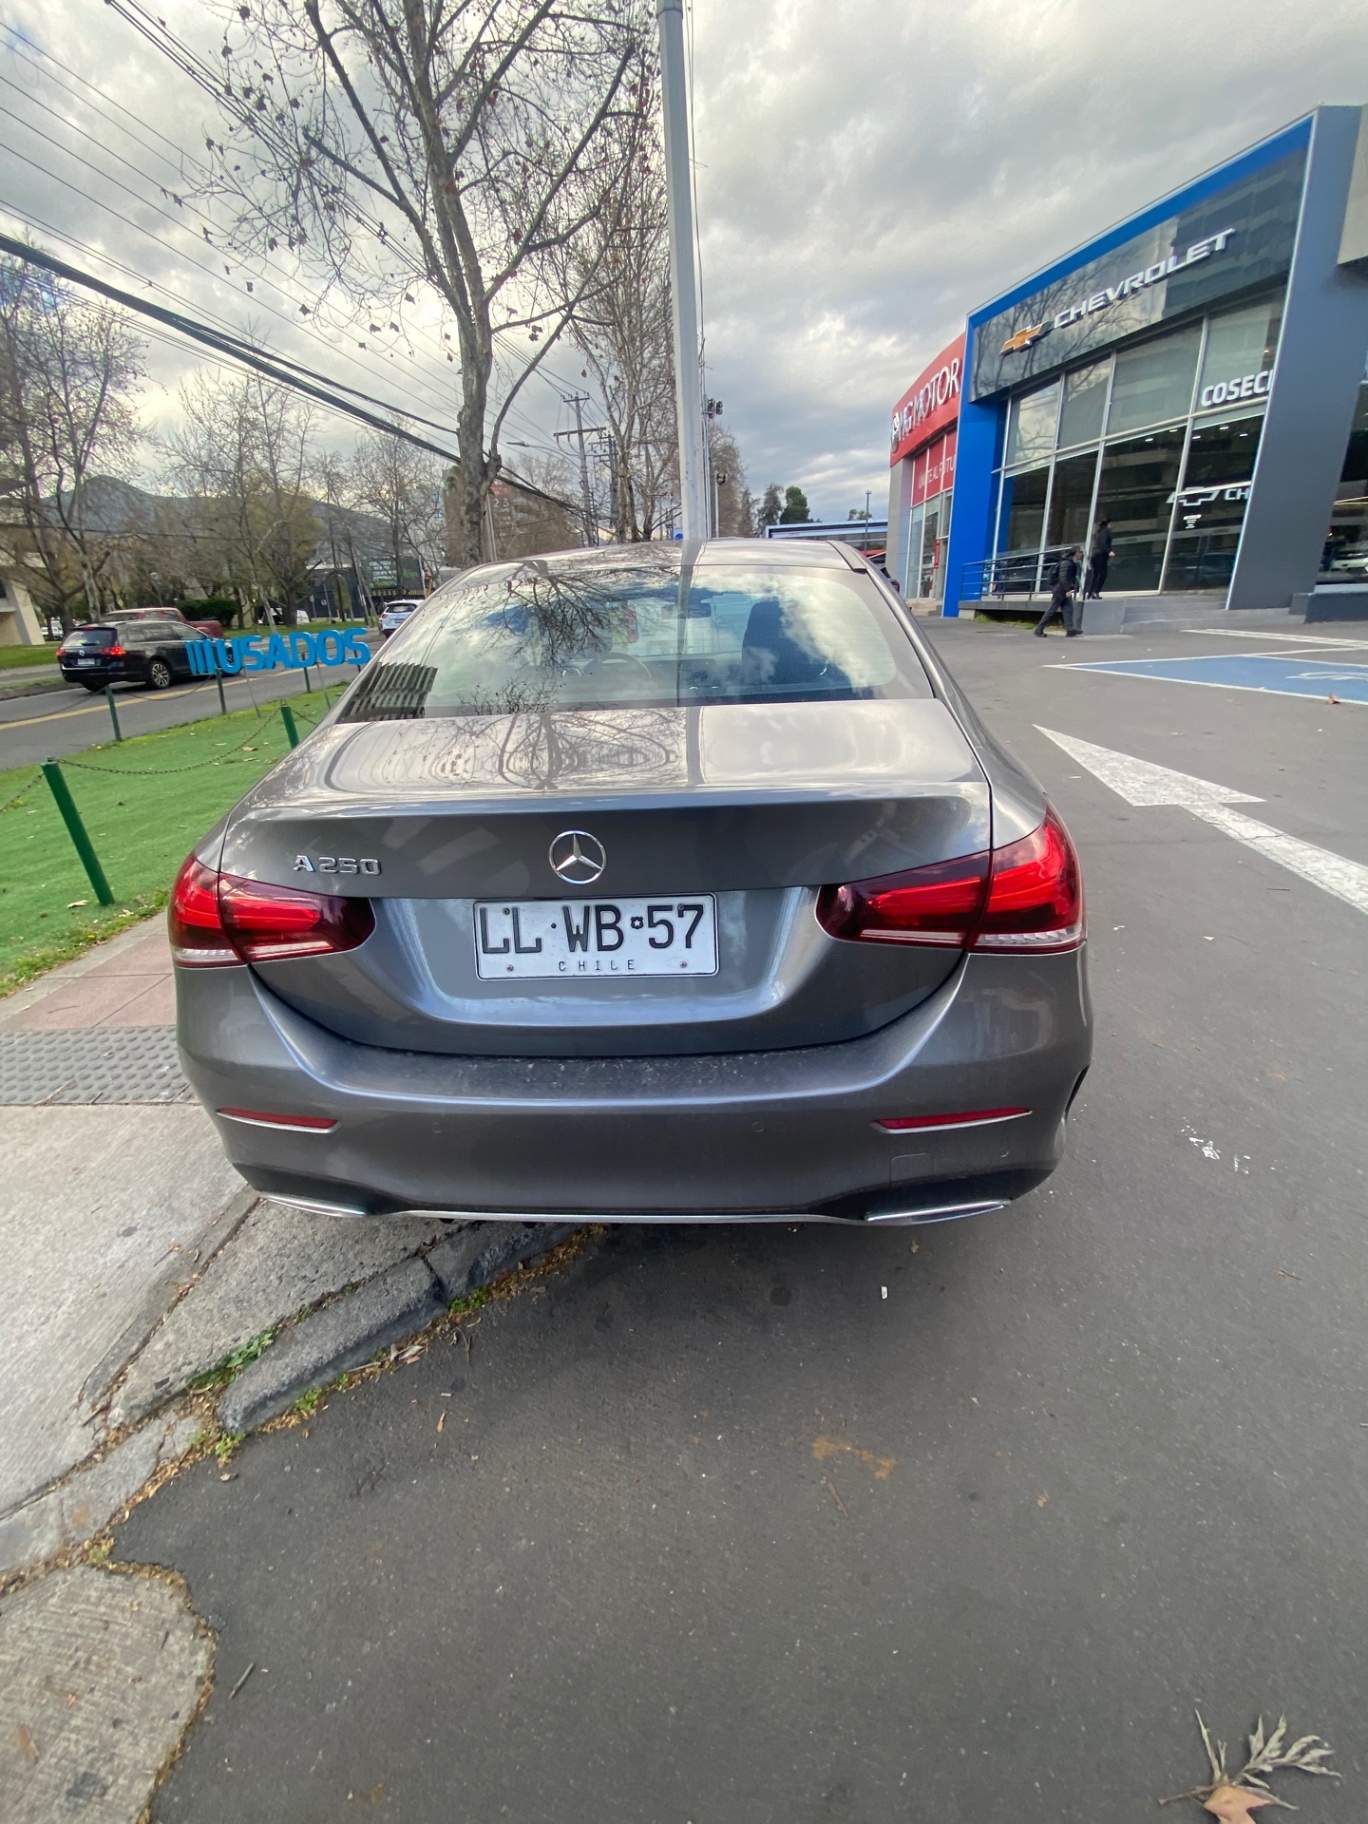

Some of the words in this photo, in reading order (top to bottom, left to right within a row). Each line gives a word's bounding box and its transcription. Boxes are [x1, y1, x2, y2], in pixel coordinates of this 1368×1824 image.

[1053, 227, 1237, 330] CHEVROLET
[914, 357, 960, 428] MOTOR
[215, 627, 373, 675] USADOS
[292, 854, 316, 873] A
[318, 855, 382, 876] 250
[558, 958, 635, 972] CHILE
